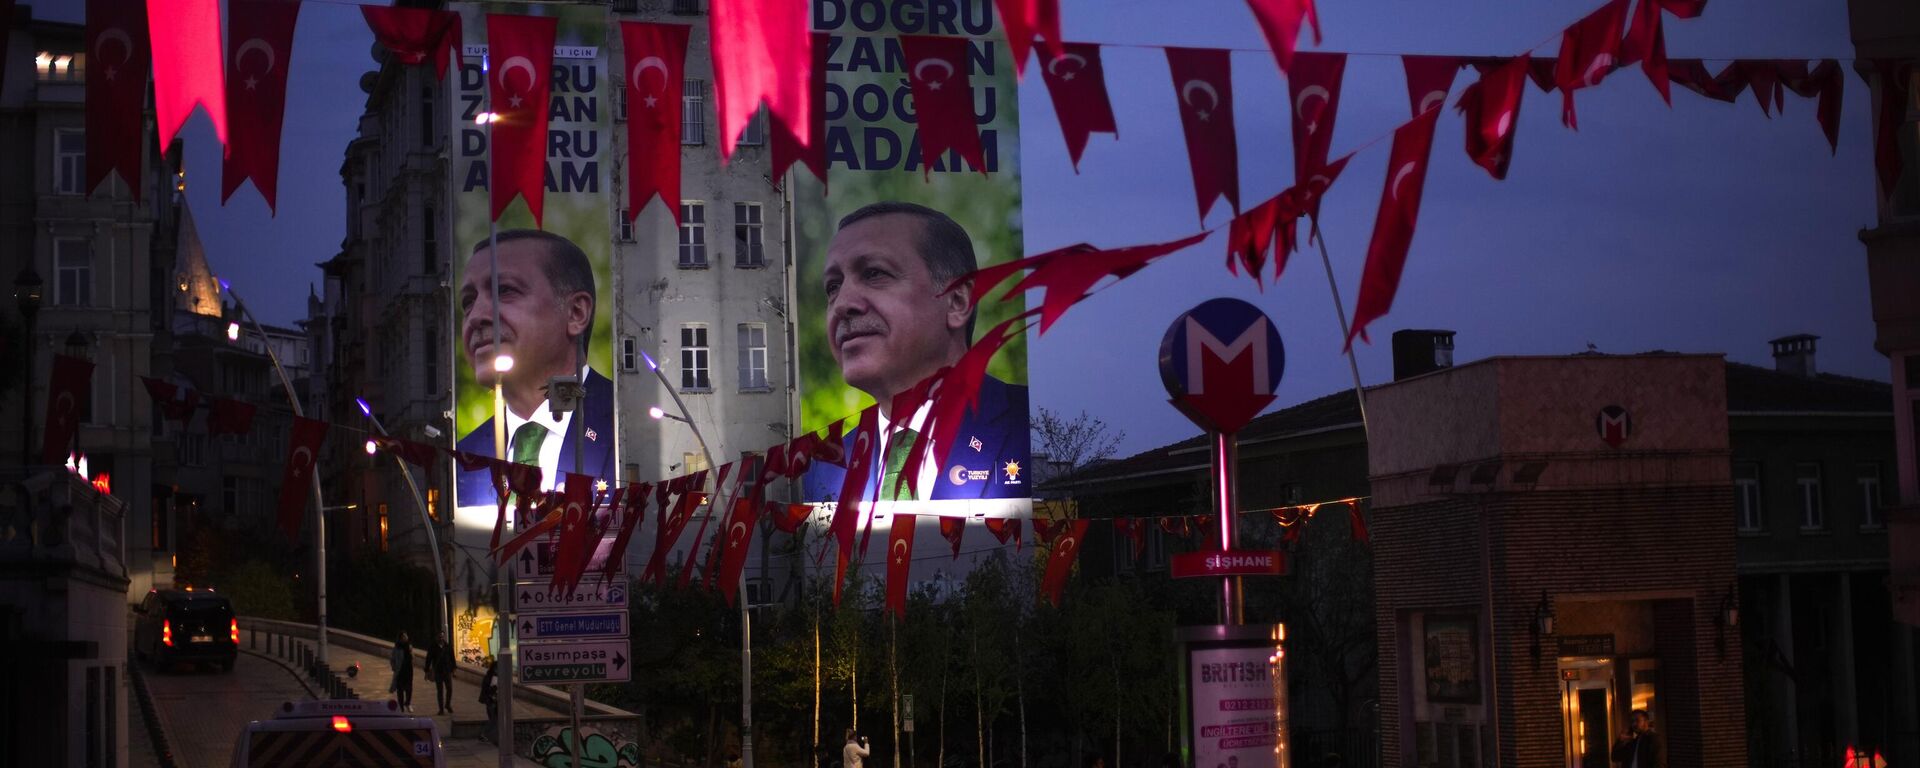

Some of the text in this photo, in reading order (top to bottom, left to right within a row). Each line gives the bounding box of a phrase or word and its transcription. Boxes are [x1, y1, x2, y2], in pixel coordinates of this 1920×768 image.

[826, 36, 995, 76] ZAMN
[460, 63, 596, 93] DRU
[461, 95, 597, 123] ZAN
[825, 79, 996, 125] DOĞU
[461, 129, 598, 158] DRU
[1186, 314, 1270, 395] M
[1601, 410, 1627, 439] M
[1205, 554, 1273, 570] ŞİŞHANE
[535, 591, 603, 605] Otopark
[525, 649, 607, 662] Kasımpaşa
[524, 664, 606, 679] Çevreyolu
[415, 743, 429, 753] 34
